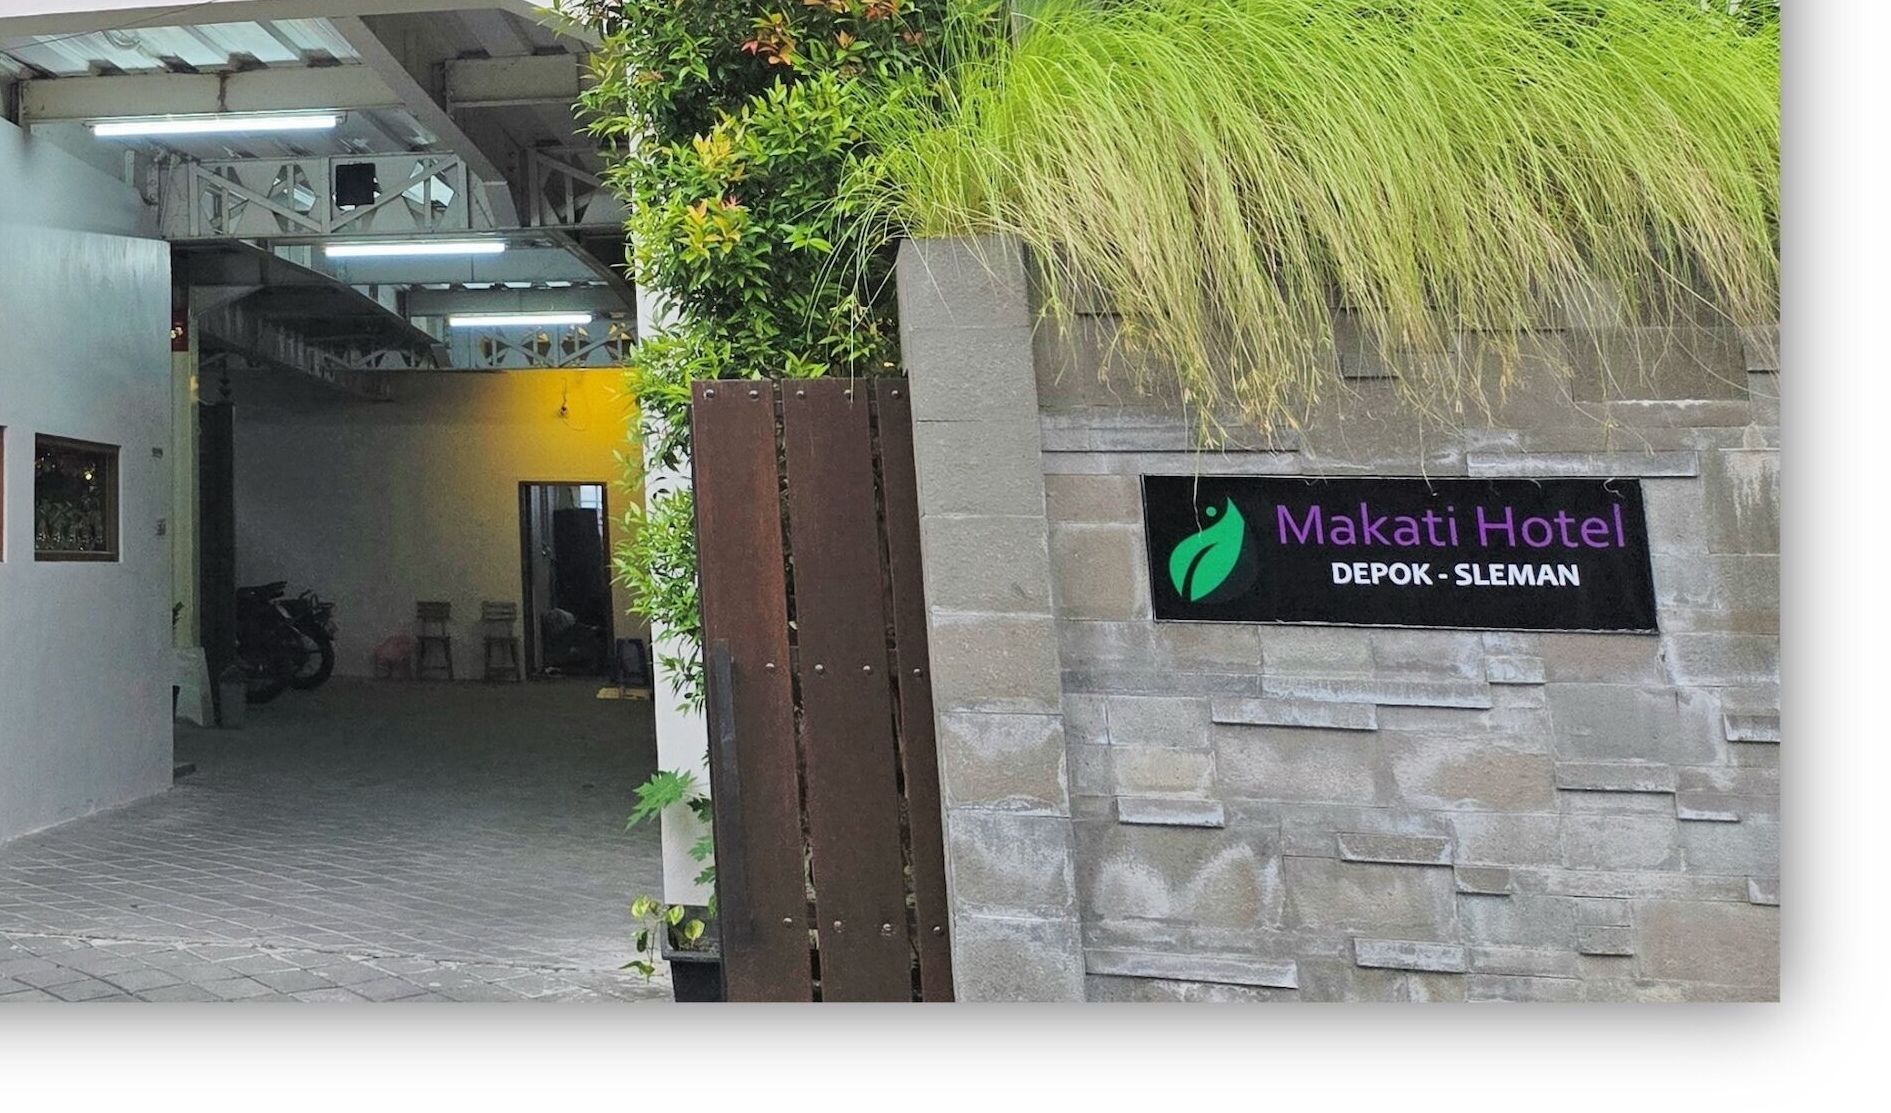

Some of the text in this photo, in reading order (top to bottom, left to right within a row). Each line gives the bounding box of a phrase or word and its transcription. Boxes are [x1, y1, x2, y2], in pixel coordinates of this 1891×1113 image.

[1277, 502, 1625, 549] Makati Hotel
[1331, 562, 1434, 586] DEPOK
[1454, 563, 1581, 587] SLEMAN
